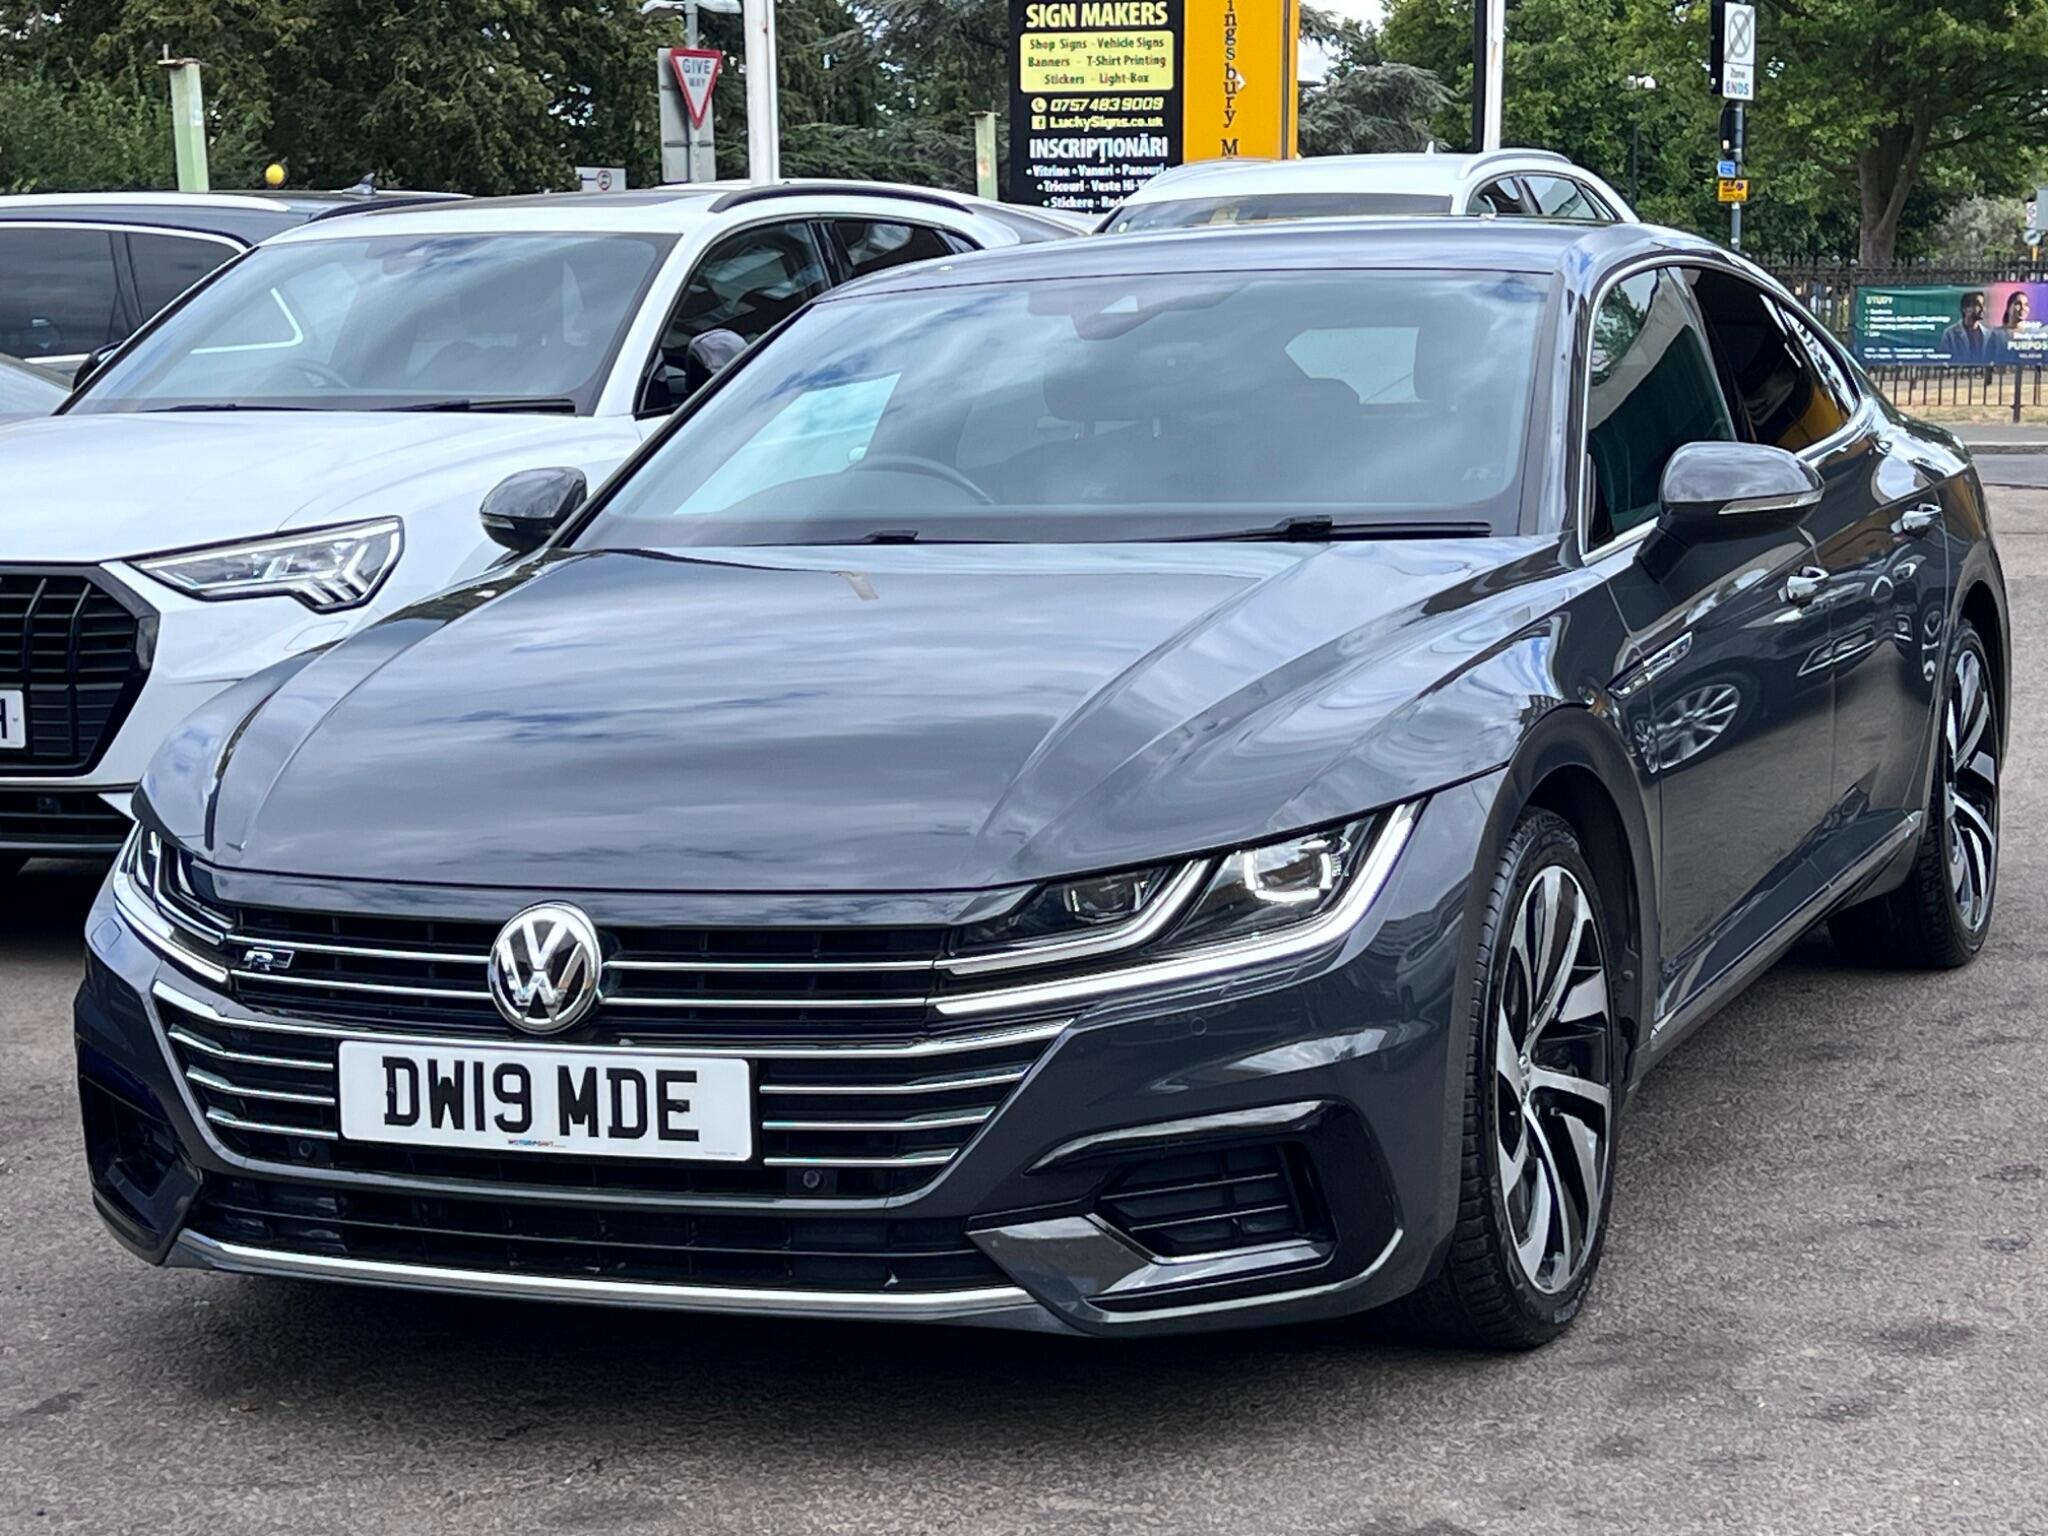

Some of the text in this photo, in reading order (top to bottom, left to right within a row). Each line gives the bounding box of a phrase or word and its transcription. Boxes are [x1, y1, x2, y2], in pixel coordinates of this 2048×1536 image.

[1026, 1, 1168, 28] SIGN MAKERS
[1030, 36, 1164, 51] Shop Signs Vehicle Signs
[682, 58, 711, 74] GIVE
[1028, 54, 1166, 68] Banners T-Shirt Printing
[1044, 72, 1149, 86] Stickers Light-Box
[1725, 80, 1750, 96] ENDS
[1049, 114, 1164, 132] LuckySigns.co.uk
[1032, 164, 1070, 177] Vitrine
[1043, 180, 1085, 192] Tricouri
[1090, 180, 1121, 192] Veste
[1050, 196, 1094, 208] Stickere
[382, 1055, 700, 1142] DW19 MDE
